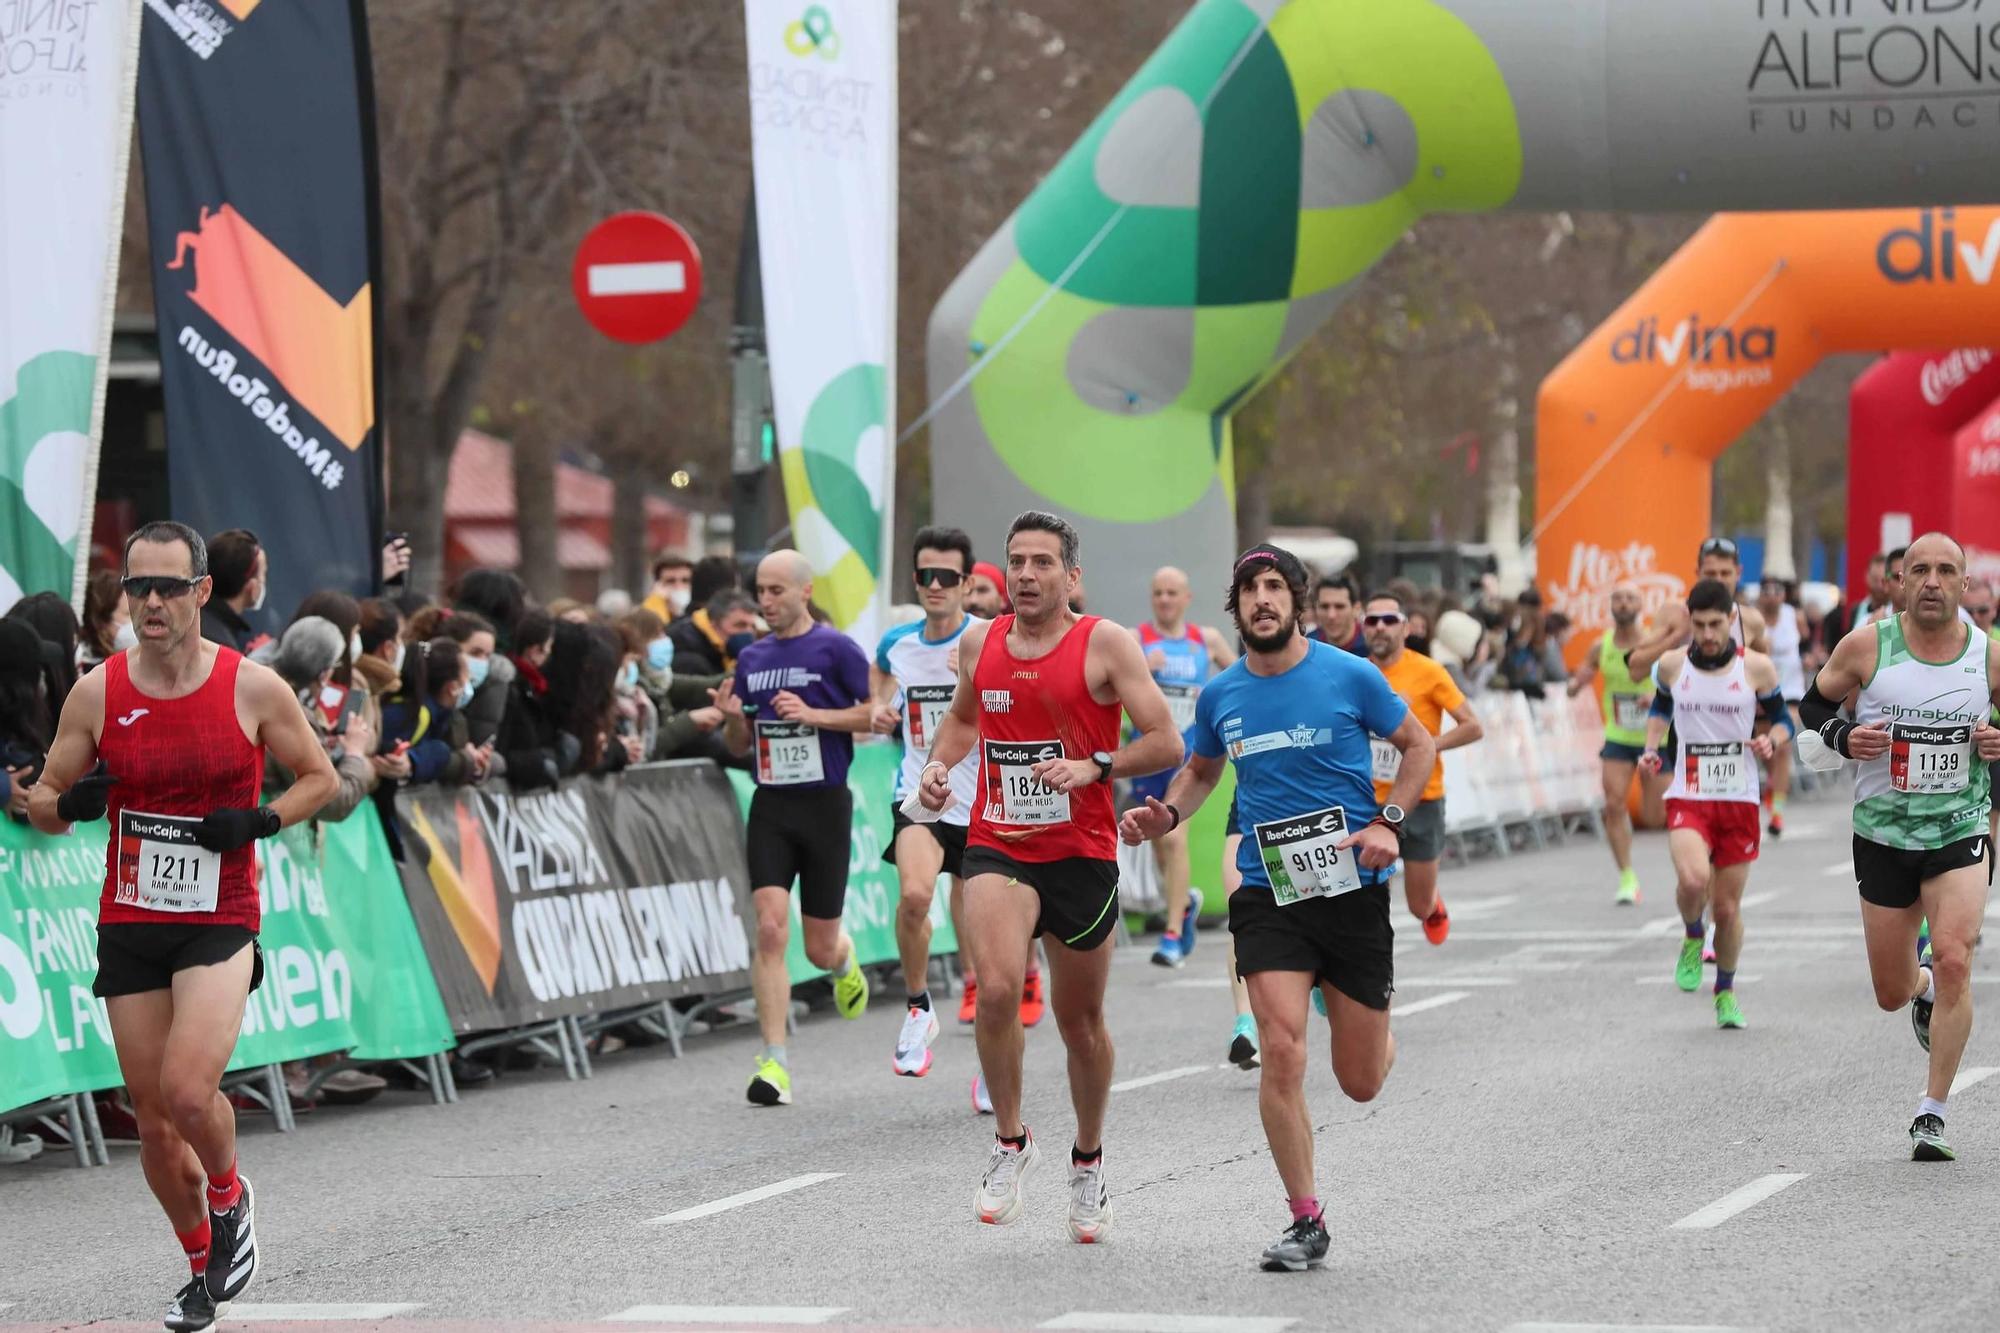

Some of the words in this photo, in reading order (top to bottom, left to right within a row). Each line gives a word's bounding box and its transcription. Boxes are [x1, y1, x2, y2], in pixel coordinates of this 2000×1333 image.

[1750, 101, 2000, 134] FUNDAC
[1611, 313, 1776, 366] divina
[1900, 729, 1944, 743] iberCaja
[775, 745, 809, 763] 1125
[991, 748, 1029, 762] iberCaja
[1920, 752, 1959, 771] 1139
[1707, 764, 1736, 777] 1470
[130, 819, 181, 841] iberCaja
[1266, 824, 1311, 841] iberCaja
[152, 853, 200, 882] 1211
[1291, 844, 1338, 873] 9193
